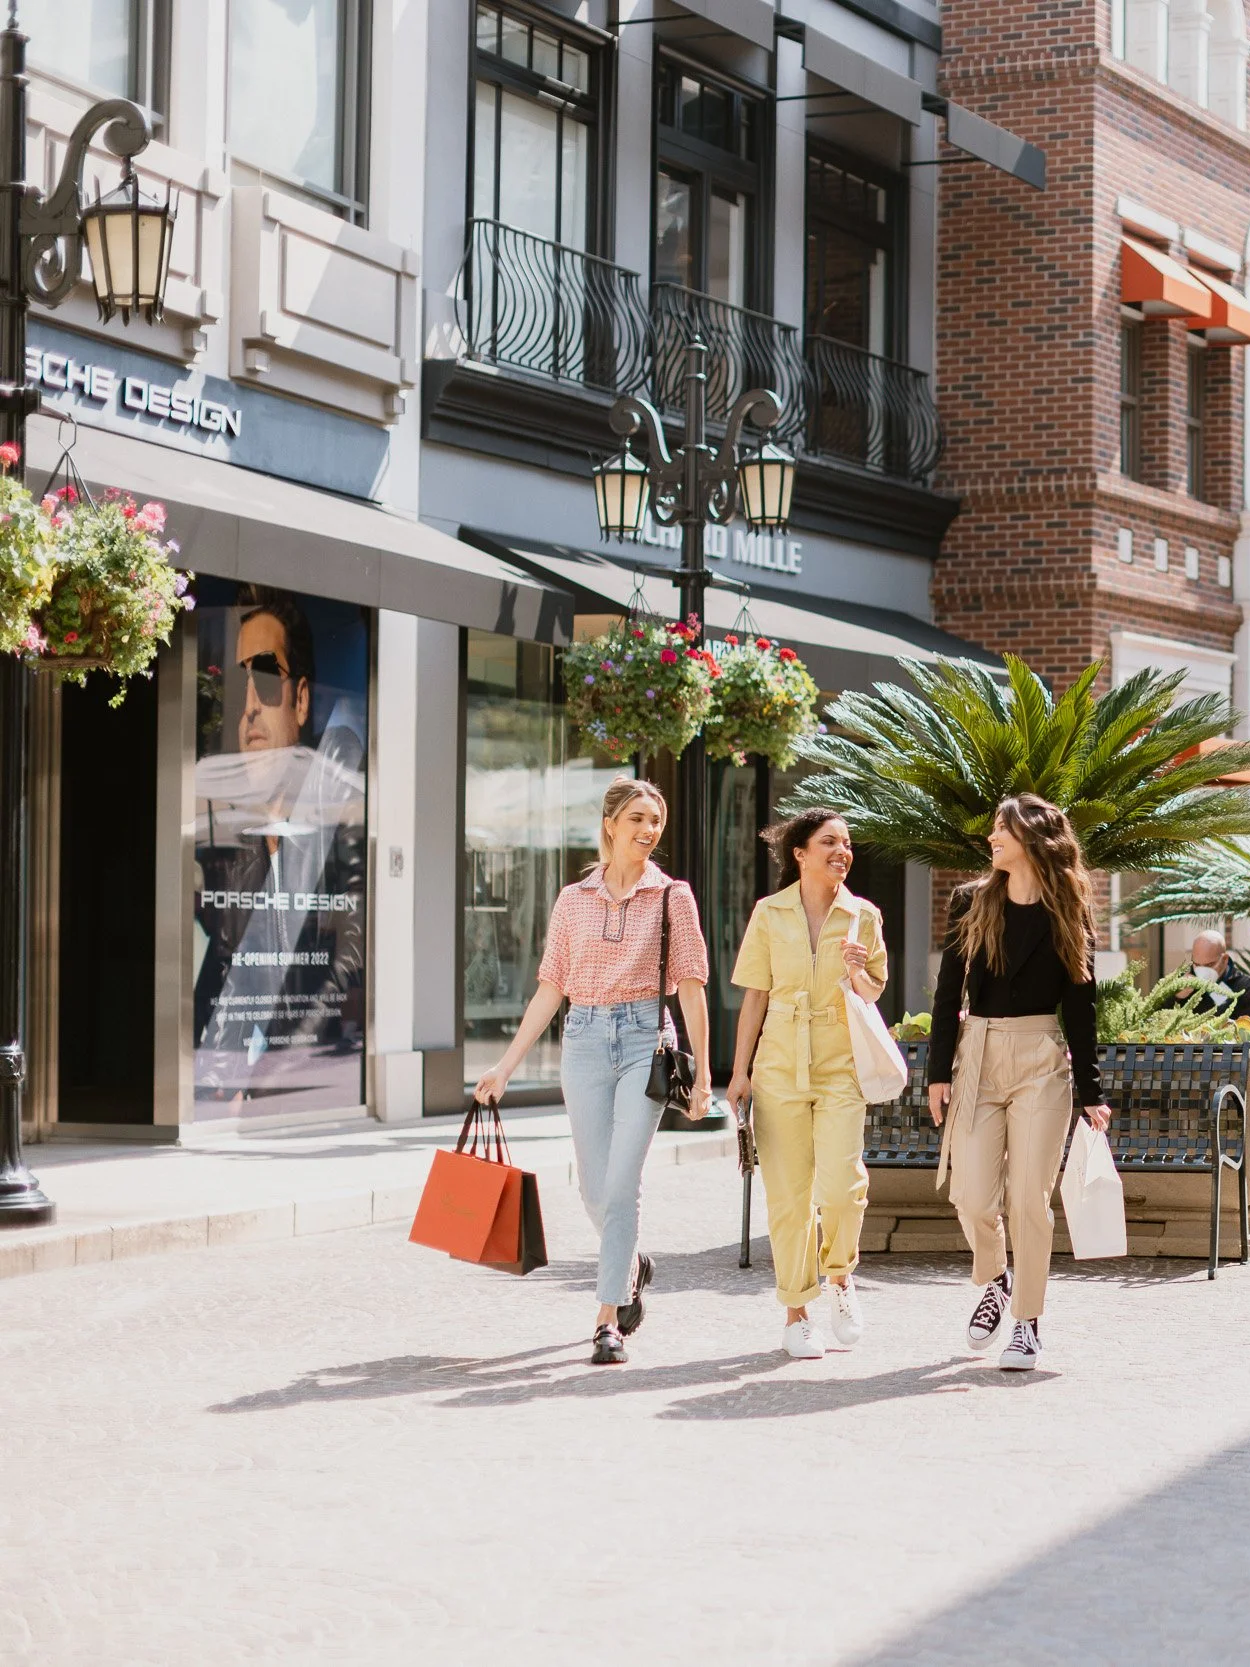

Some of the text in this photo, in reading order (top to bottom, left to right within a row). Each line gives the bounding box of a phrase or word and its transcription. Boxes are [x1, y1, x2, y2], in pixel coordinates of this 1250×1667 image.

[124, 376, 242, 437] DESIGN
[732, 529, 802, 574] MILLE
[200, 890, 357, 912] PORSCHE DESIGN
[231, 951, 329, 967] RE-OPENING SUMMER 2022
